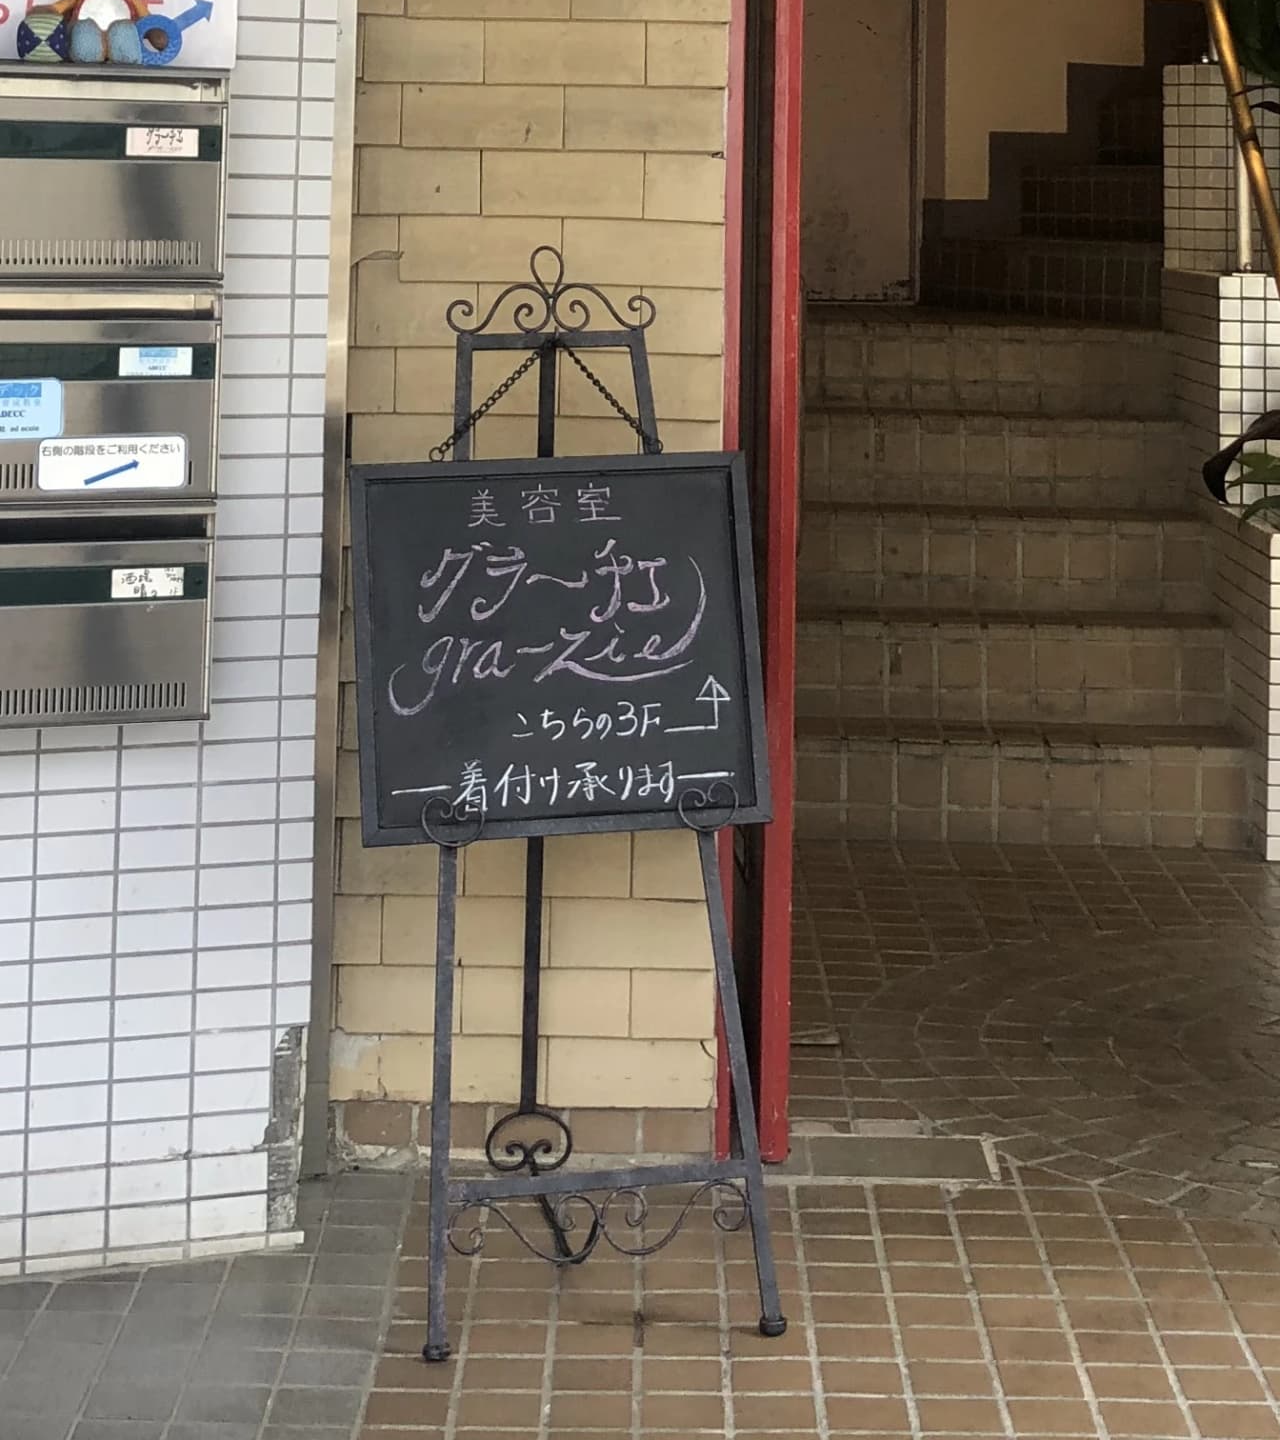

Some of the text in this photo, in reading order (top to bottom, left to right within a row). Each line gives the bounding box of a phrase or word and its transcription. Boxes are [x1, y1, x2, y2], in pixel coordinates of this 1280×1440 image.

[41, 443, 181, 457] 右側の階段をご利用ください
[467, 482, 623, 528] 美容室
[511, 701, 662, 741] こちらの3F
[452, 758, 676, 814] 着付け承ります
